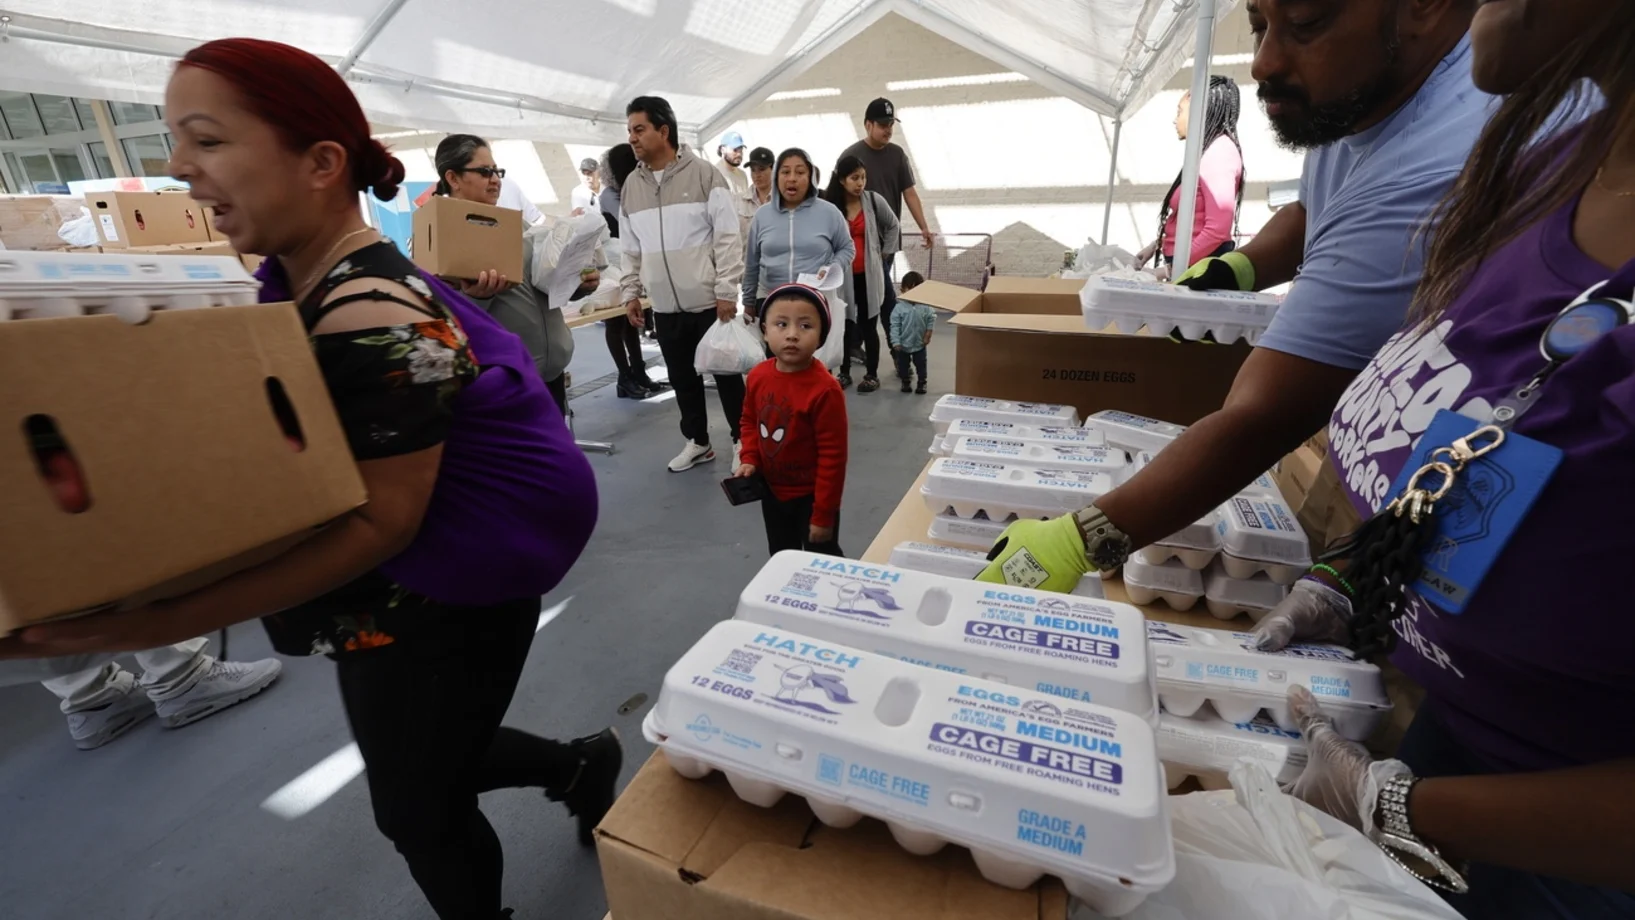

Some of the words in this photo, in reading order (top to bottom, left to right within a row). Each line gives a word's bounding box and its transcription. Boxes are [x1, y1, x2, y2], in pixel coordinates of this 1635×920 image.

[1042, 369, 1056, 380] 24
[1060, 369, 1100, 382] DOZEN
[1104, 371, 1136, 383] EGGS
[1038, 479, 1088, 489] HATCH
[810, 558, 901, 583] HATCH
[764, 594, 780, 604] 12
[781, 597, 818, 612] EGGS
[984, 590, 1036, 604] EGGS
[1002, 603, 1048, 612] AMERICA'S
[1050, 610, 1070, 618] EGG
[1071, 613, 1113, 624] FARMERS
[1034, 614, 1119, 639] MEDIUM
[753, 632, 862, 669] HATCH
[972, 623, 1038, 642] CAGE
[1046, 634, 1113, 656] FREE
[964, 637, 987, 646] EGGS
[990, 641, 1016, 652] FROM
[1018, 647, 1042, 656] FREE
[1044, 650, 1090, 664] ROAMING
[1092, 658, 1118, 668] HENS
[1206, 664, 1232, 677] CAGE
[1235, 666, 1258, 679] FREE
[1310, 675, 1341, 687] GRADE
[1343, 678, 1350, 688] A
[690, 675, 709, 688] 12
[711, 680, 754, 701] EGGS
[958, 685, 1020, 707] EGGS
[1036, 682, 1078, 700] GRADE
[1080, 691, 1092, 702] A
[1312, 684, 1350, 698] MEDIUM
[948, 697, 977, 708] FROM
[980, 704, 1034, 720] AMERICA'S
[1038, 714, 1060, 726] EGG
[1063, 720, 1115, 738] FARMERS
[1016, 720, 1122, 758] MEDIUM
[1235, 722, 1302, 740] ATCH
[938, 726, 1020, 758] CAGE
[1030, 745, 1114, 781] FREE
[848, 763, 888, 788] CAGE
[892, 776, 930, 800] FREE
[928, 743, 956, 756] EGGS
[959, 750, 992, 765] FROM
[994, 758, 1024, 774] FREE
[1027, 766, 1084, 788] ROAMING
[1086, 780, 1120, 796] HENS
[1018, 808, 1072, 836] GRADE
[1074, 824, 1087, 841] A
[1016, 826, 1083, 856] MEDIUM
